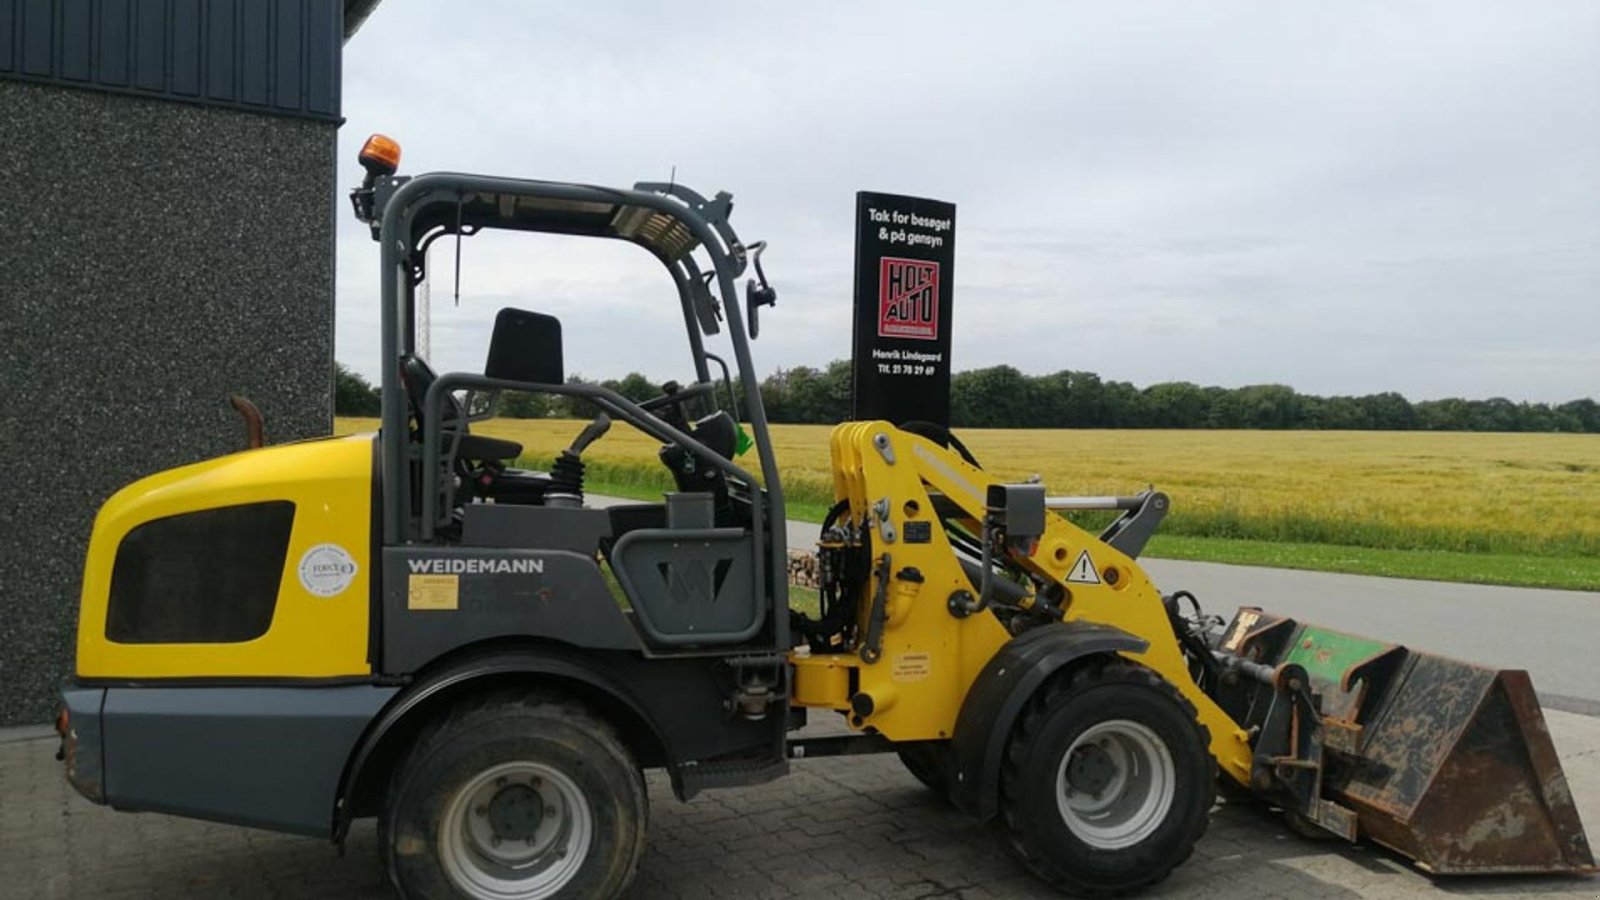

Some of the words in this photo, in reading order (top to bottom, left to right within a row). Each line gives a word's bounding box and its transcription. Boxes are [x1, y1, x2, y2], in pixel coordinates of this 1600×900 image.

[869, 208, 890, 222] Tak
[892, 210, 909, 224] for
[911, 212, 951, 231] besøget
[879, 227, 888, 240] &
[890, 229, 906, 243] på
[908, 233, 943, 248] gensyn
[889, 264, 933, 301] HOLT
[886, 286, 933, 323] AUTO
[872, 348, 900, 360] Henrik
[902, 350, 942, 362] Lindegaard
[903, 365, 912, 374] 78
[914, 366, 924, 375] 29
[408, 559, 544, 574] WEIDEMANN
